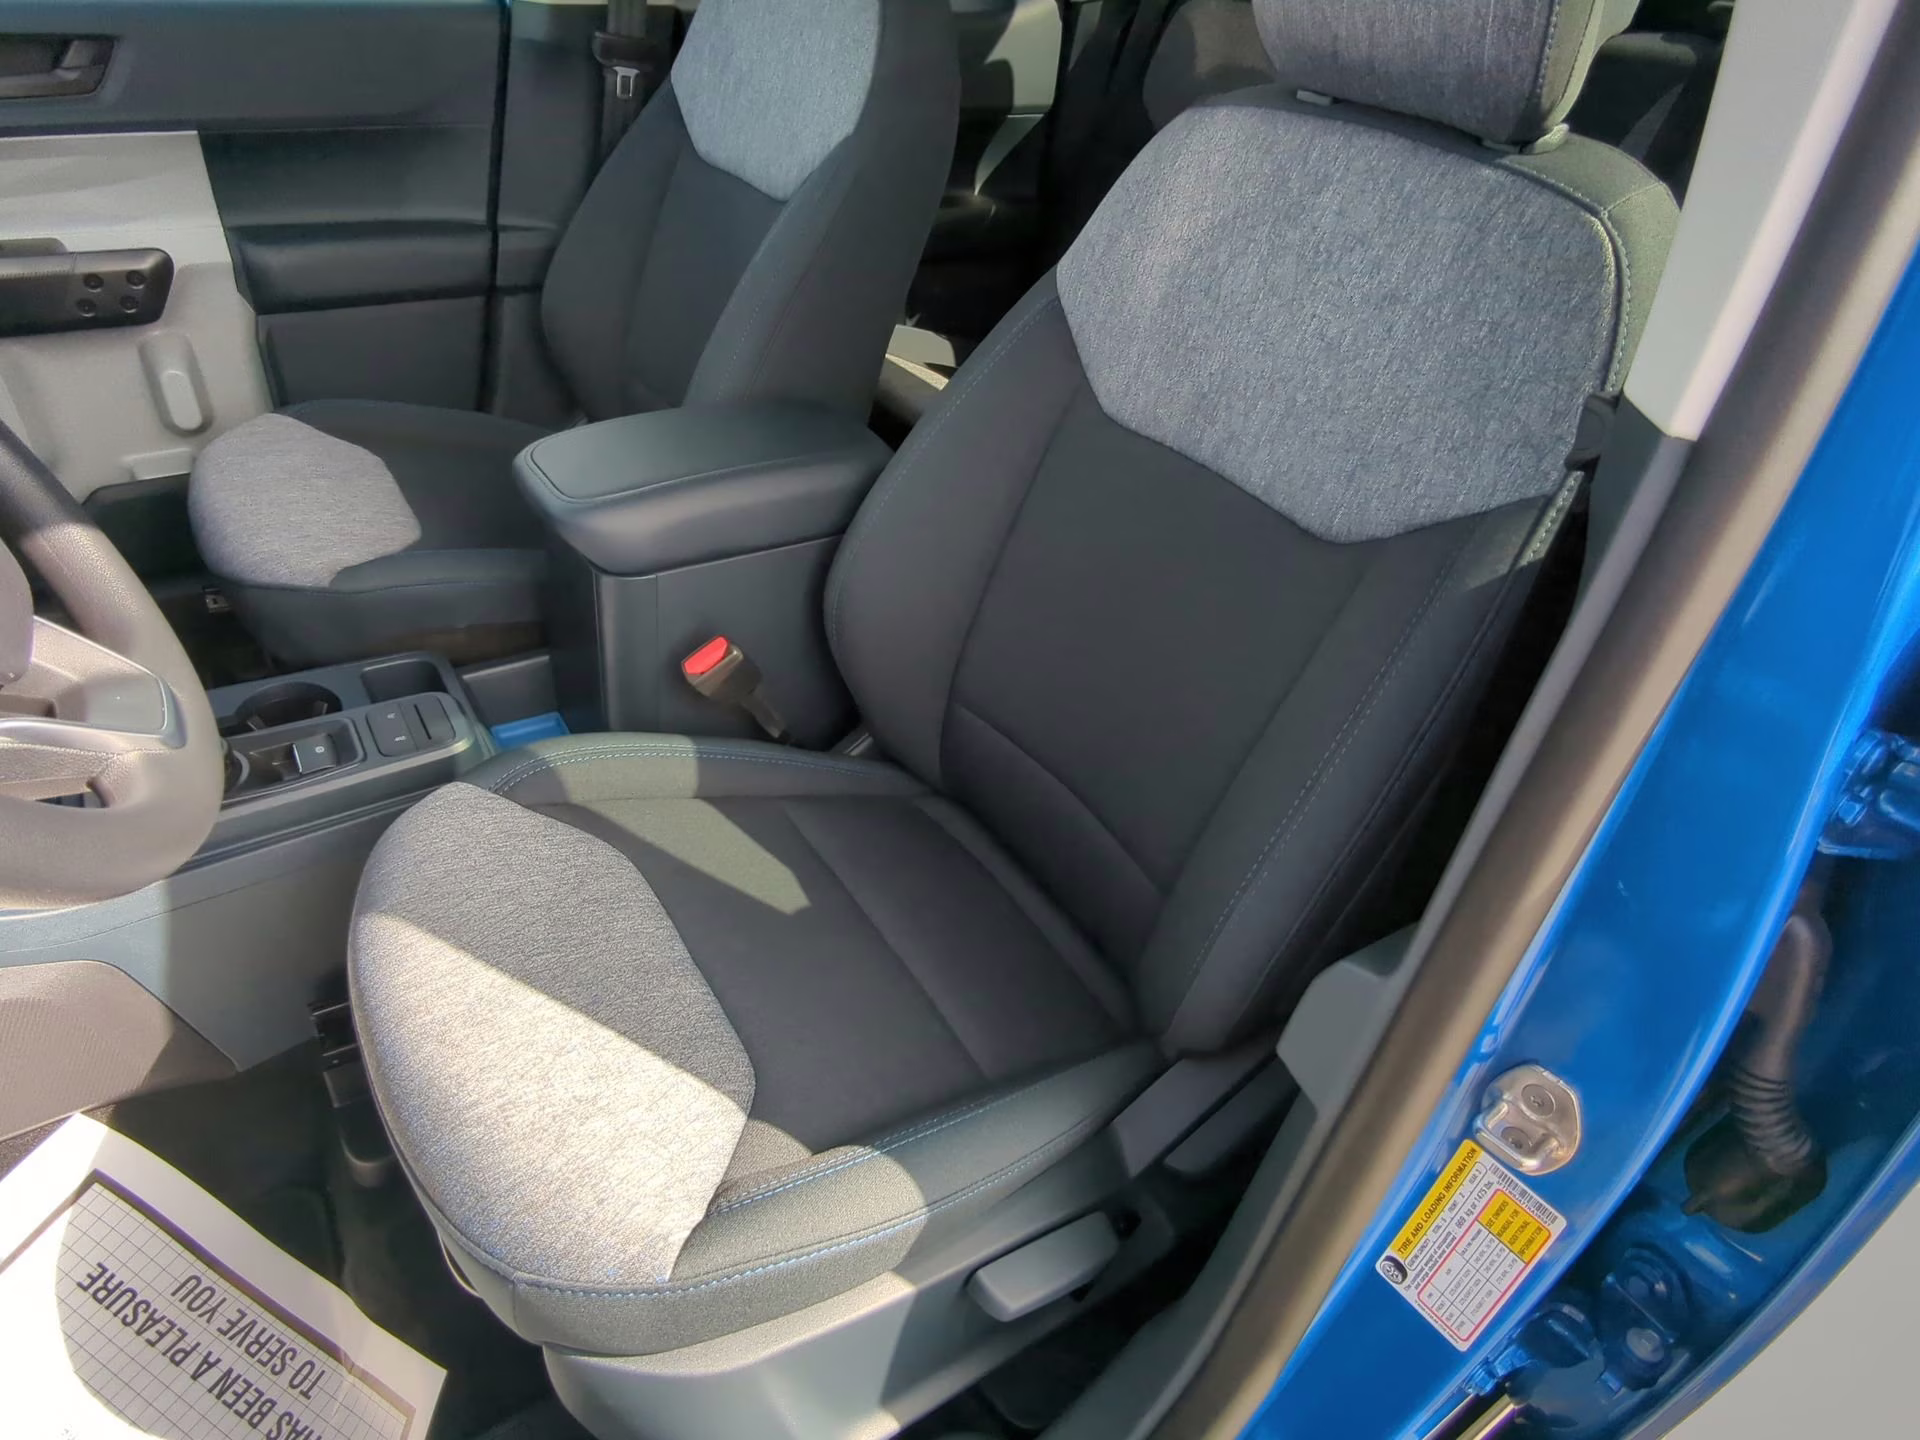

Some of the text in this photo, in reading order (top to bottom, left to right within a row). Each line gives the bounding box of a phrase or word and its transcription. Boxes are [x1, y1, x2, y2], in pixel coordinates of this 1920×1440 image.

[1397, 1146, 1477, 1255] TIRE AND LOADING INFORMATION
[1454, 1215, 1466, 1229] 669
[1463, 1206, 1474, 1218] kg
[1469, 1201, 1477, 1210] or
[1473, 1186, 1488, 1203] 1475
[77, 1262, 199, 1368] PLEASURE
[171, 1274, 326, 1400] TO SERVE YOU
[191, 1351, 222, 1382] A
[206, 1366, 278, 1430] BEEN
